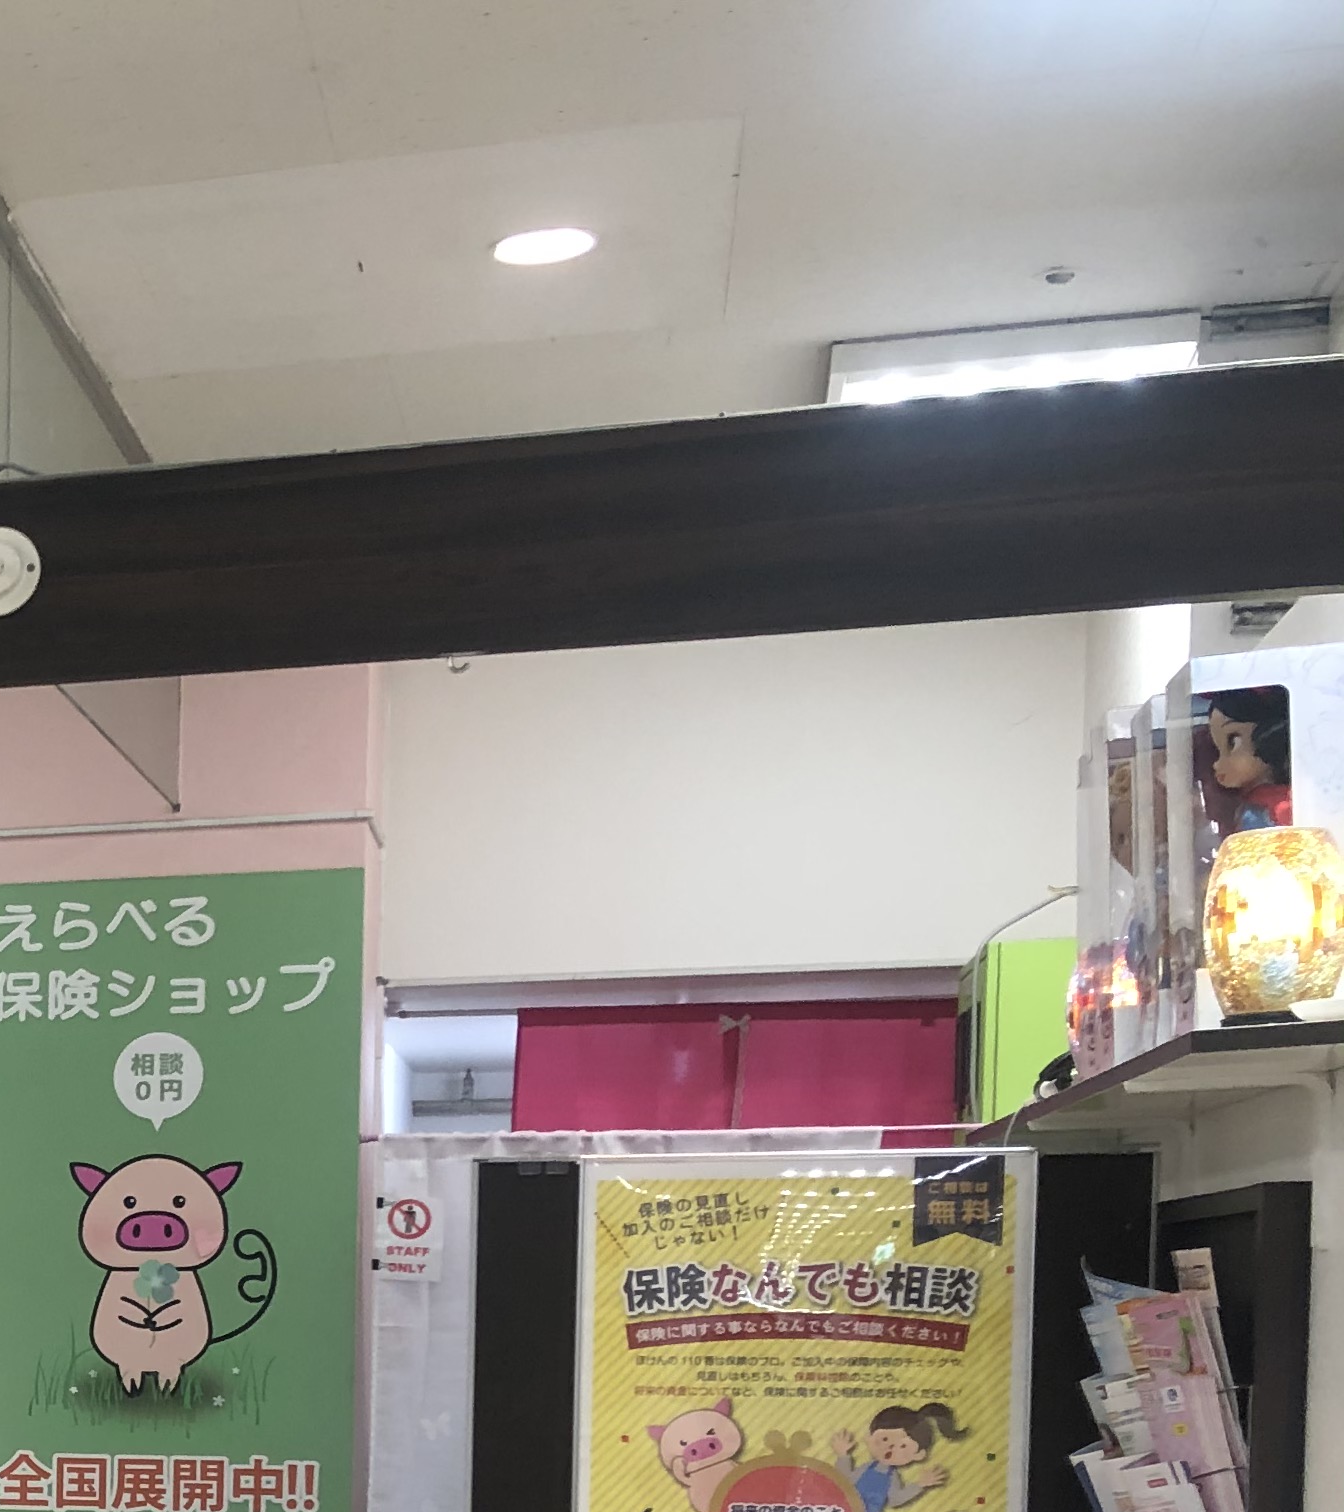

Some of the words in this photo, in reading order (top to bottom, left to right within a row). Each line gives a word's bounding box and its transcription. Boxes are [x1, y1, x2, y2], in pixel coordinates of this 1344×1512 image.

[130, 1053, 185, 1078] 相談
[134, 1079, 184, 1101] 0円
[638, 1191, 750, 1219] 保険の見直し
[927, 1199, 991, 1225] 無料
[622, 1204, 770, 1238] 加入のご相談だけ
[386, 1245, 430, 1257] STAFF
[387, 1262, 426, 1274] ONLY
[623, 1262, 979, 1315] 保険なんでも相談
